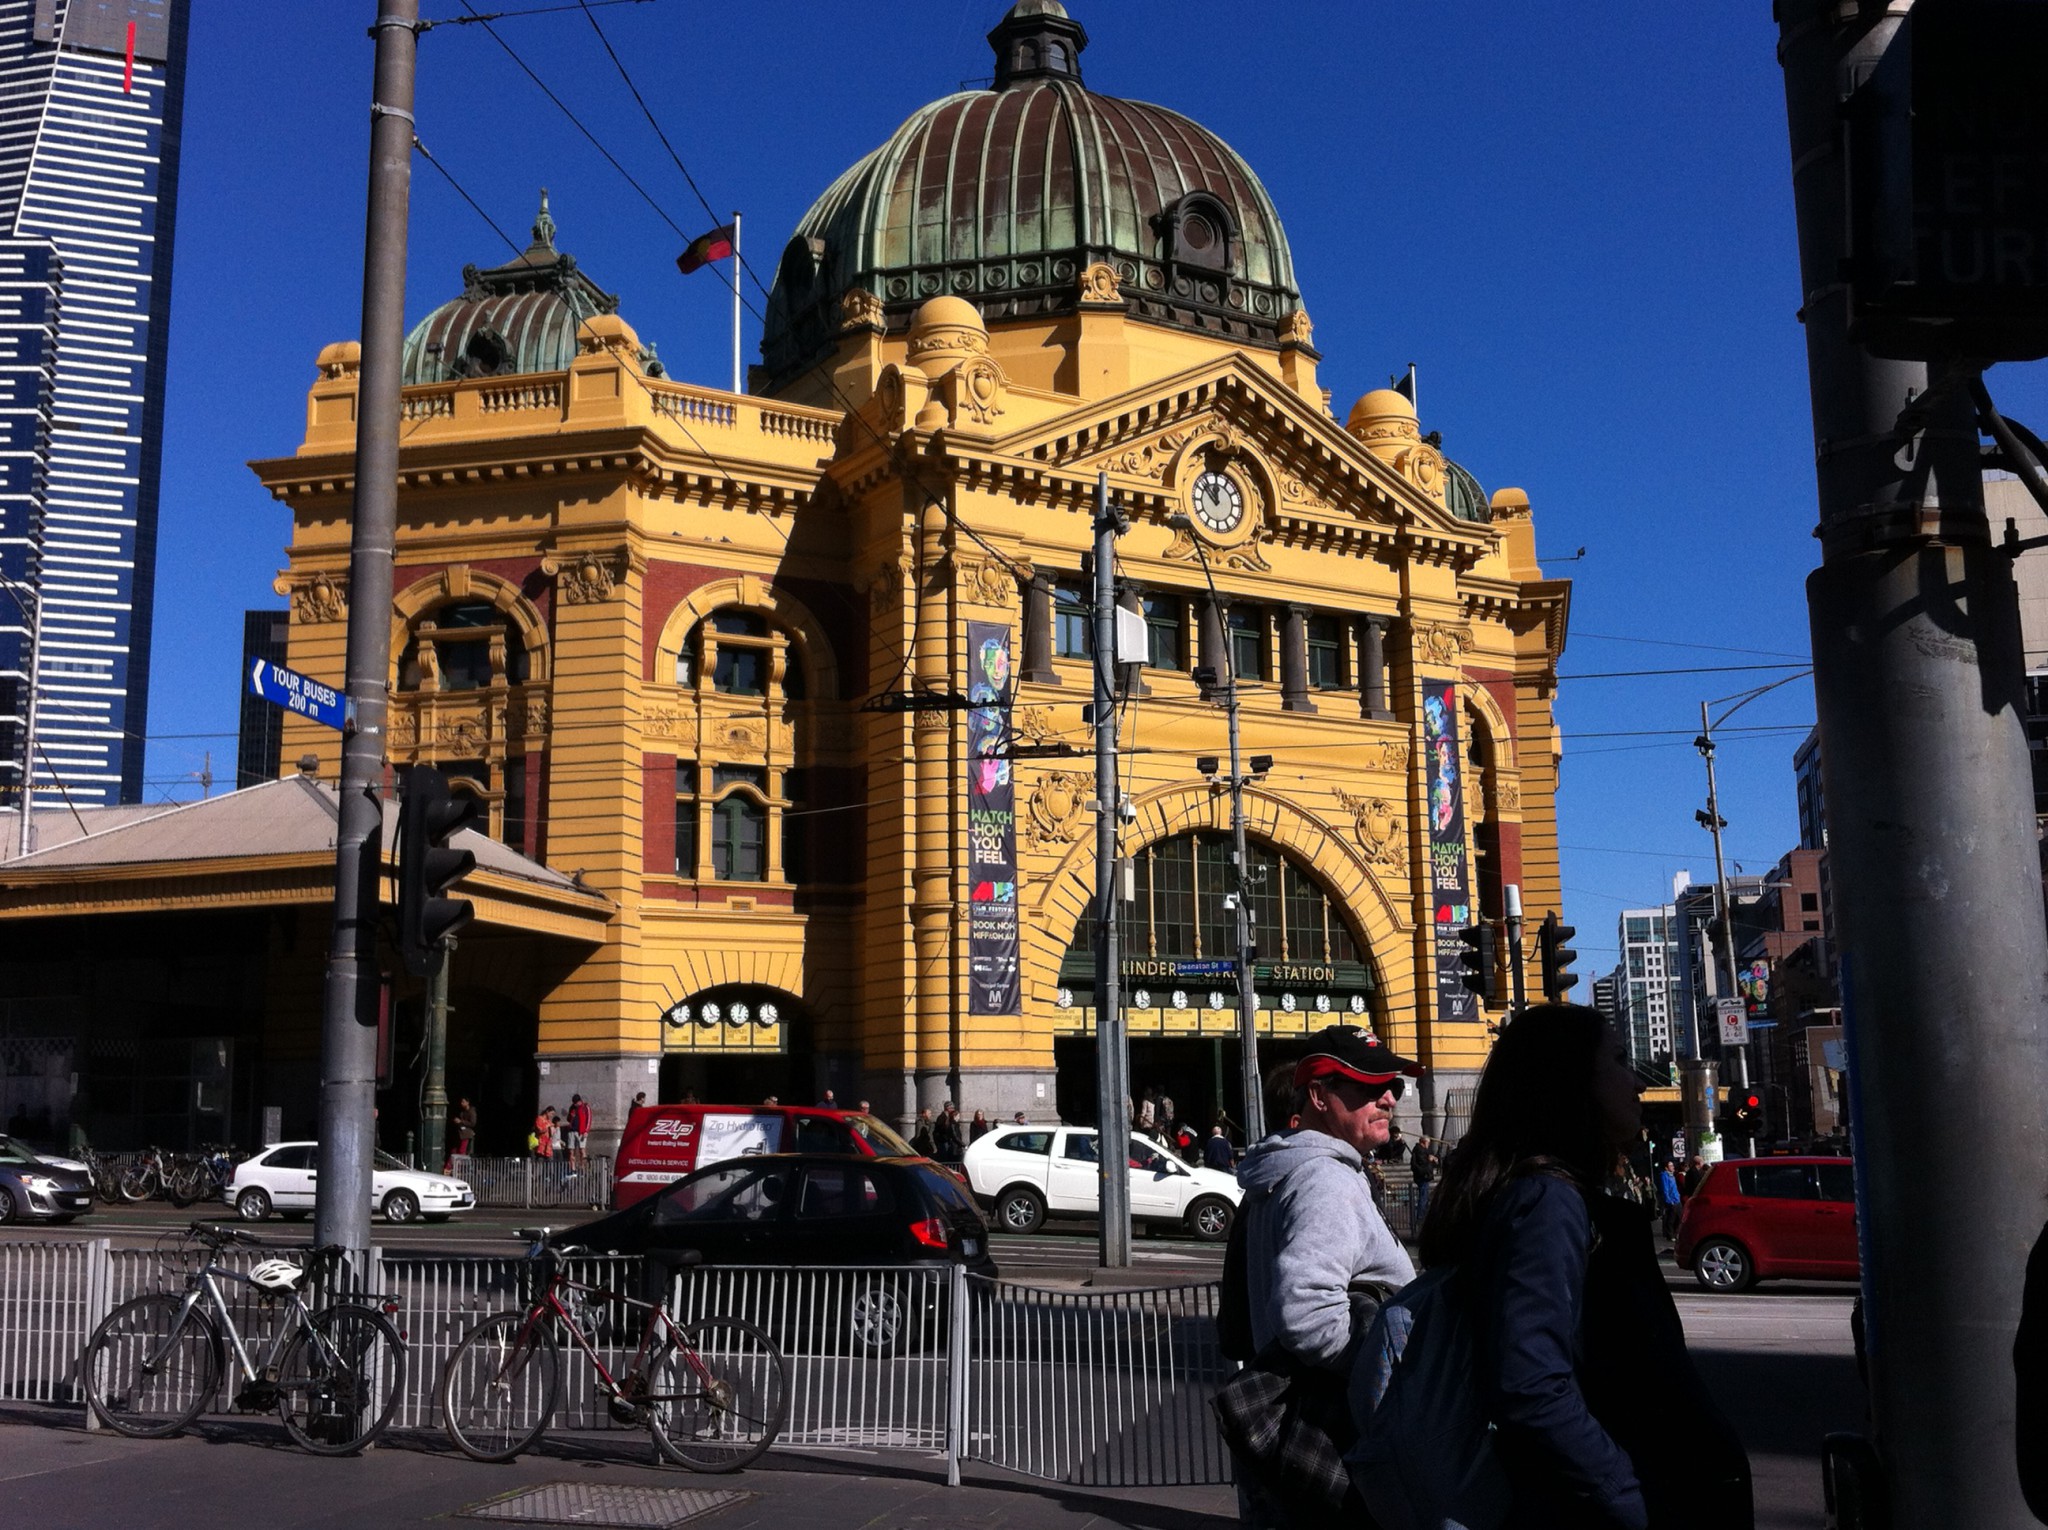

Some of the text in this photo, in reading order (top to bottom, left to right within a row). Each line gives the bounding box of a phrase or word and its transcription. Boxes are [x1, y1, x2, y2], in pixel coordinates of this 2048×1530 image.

[272, 665, 336, 707] TOUR BUSES
[289, 691, 318, 717] 200 m
[971, 809, 1013, 824] WATCH
[974, 823, 1005, 838] HOW
[972, 837, 1002, 850] YOU
[1432, 841, 1464, 856] WATCH
[975, 850, 1007, 865] FEEL
[1435, 854, 1459, 867] HOW
[1433, 865, 1457, 878] YOU
[1436, 877, 1462, 891] FEEL
[973, 920, 996, 930] BOOK
[1437, 938, 1456, 947] BOOK
[1176, 962, 1211, 971] Swanston
[1211, 961, 1219, 970] St
[1273, 965, 1336, 982] STATION
[648, 1118, 695, 1140] Zip
[708, 1119, 772, 1133] Zip HydroTap
[628, 1158, 662, 1166] INSTALLATION
[667, 1159, 689, 1167] SERVICE
